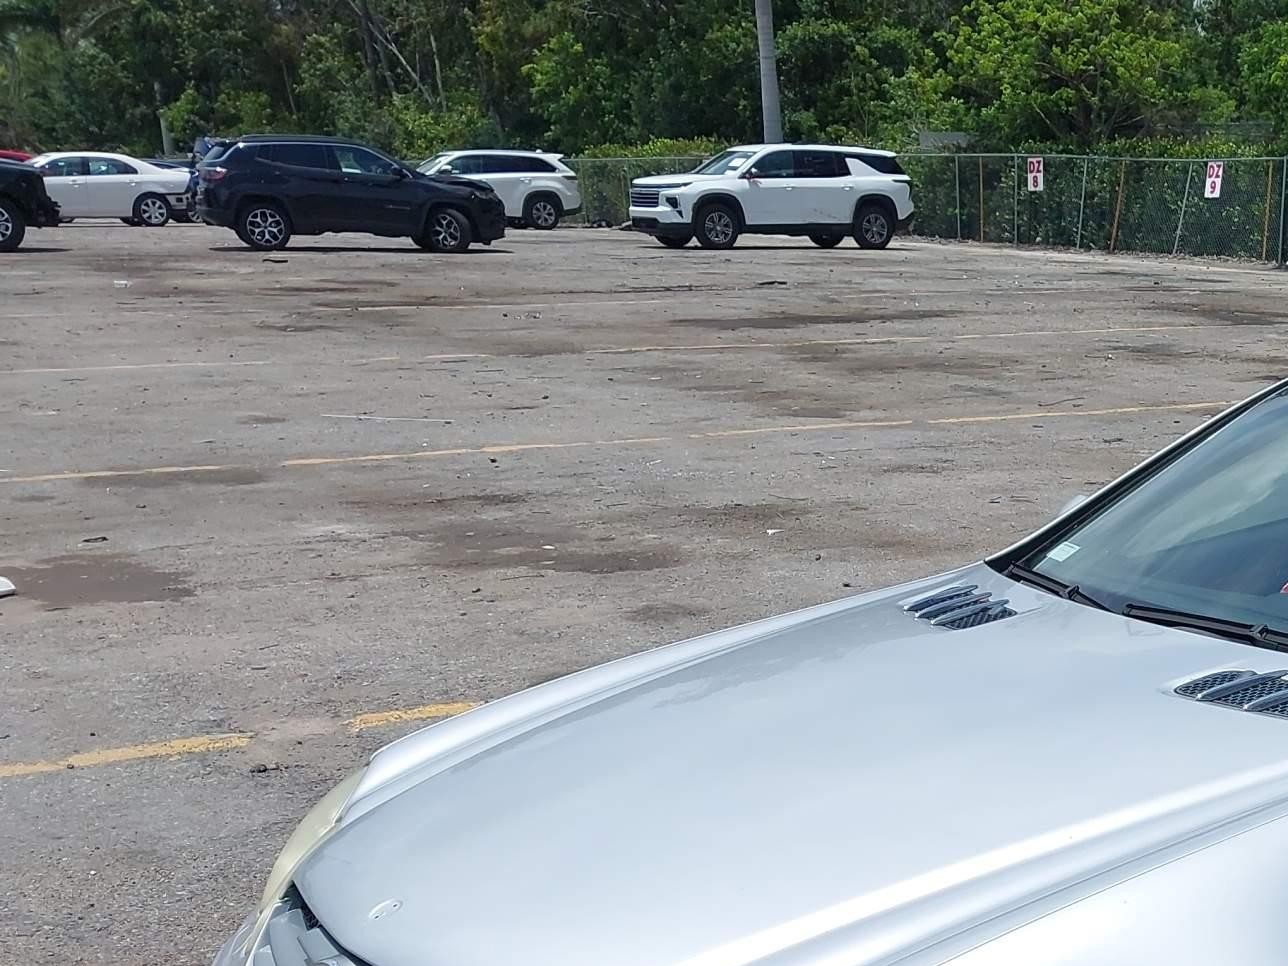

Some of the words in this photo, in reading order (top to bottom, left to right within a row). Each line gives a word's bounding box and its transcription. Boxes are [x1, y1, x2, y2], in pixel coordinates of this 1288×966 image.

[1028, 160, 1042, 174] DZ
[1207, 164, 1222, 179] DZ
[1031, 175, 1039, 188] 8
[1209, 180, 1217, 194] 9
